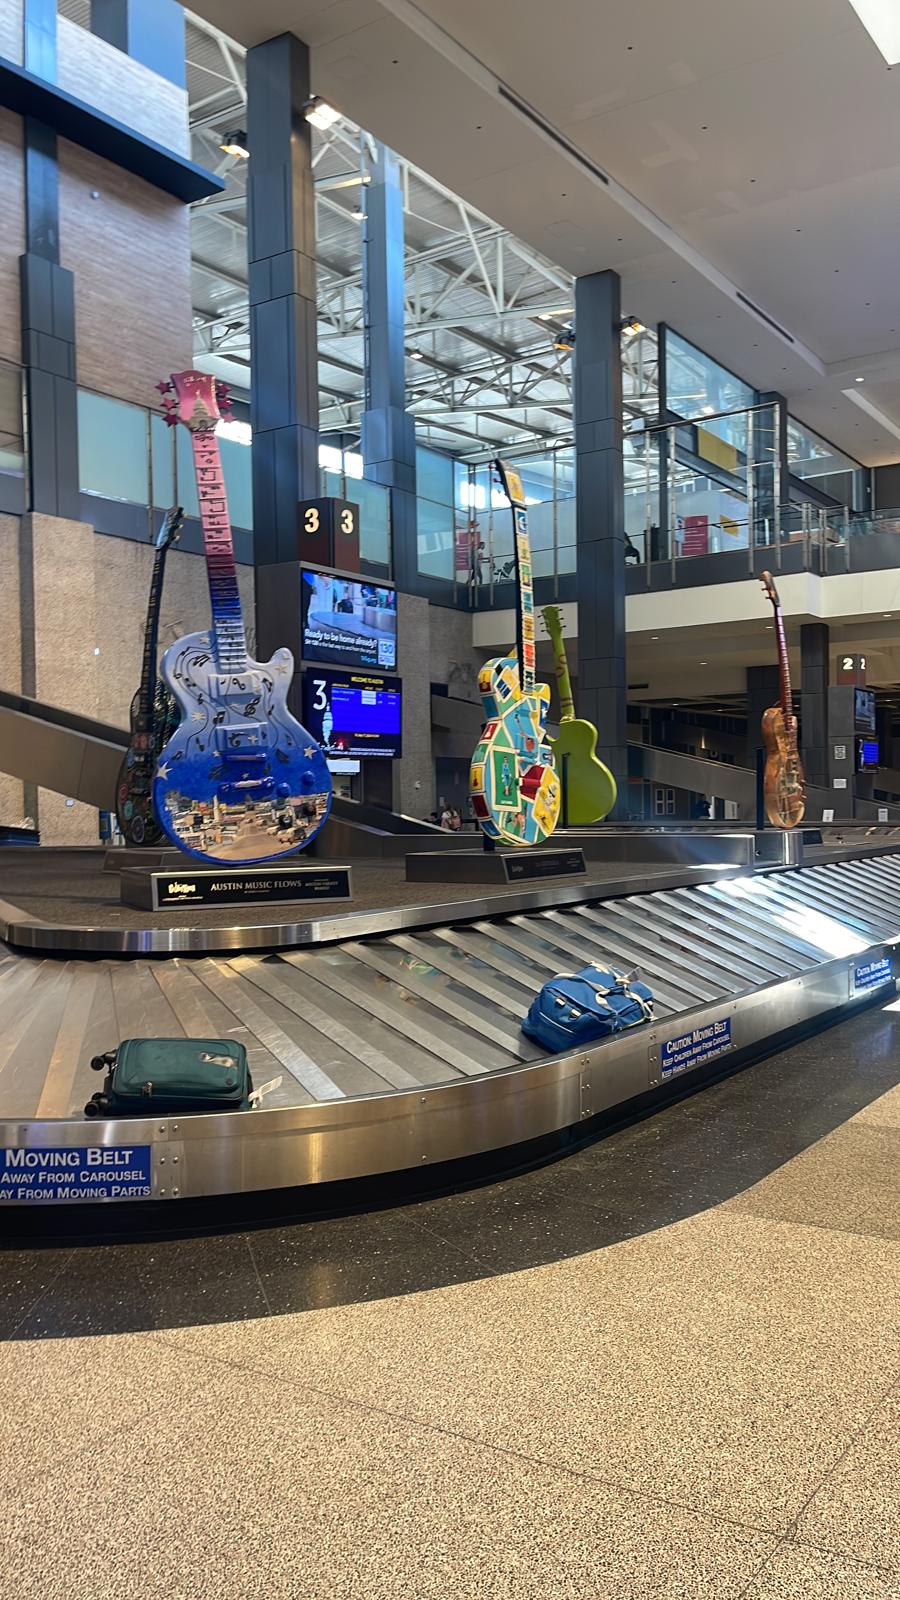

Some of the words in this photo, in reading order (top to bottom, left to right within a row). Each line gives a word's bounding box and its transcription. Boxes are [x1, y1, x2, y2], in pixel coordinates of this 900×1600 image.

[304, 508, 320, 533] 3
[341, 509, 354, 534] 3
[304, 629, 323, 640] Ready
[331, 633, 338, 641] be
[339, 634, 355, 643] home
[356, 637, 377, 648] already?
[843, 658, 853, 670] 2
[860, 658, 866, 670] 2
[313, 680, 327, 710] 3
[210, 882, 243, 891] AUSTIN
[244, 880, 273, 890] MUSIC
[274, 880, 302, 888] FLOWS
[693, 1028, 713, 1043] MOVING
[714, 1022, 727, 1034] BELT
[662, 1070, 672, 1079] KEEP
[697, 1055, 707, 1063] FROM
[663, 1058, 673, 1067] KEEP
[5, 1148, 80, 1168] MOVING
[87, 1148, 133, 1166] BELT
[1, 1172, 35, 1184] AWAY
[38, 1172, 75, 1183] FROM
[80, 1170, 146, 1182] CAROUSEL
[0, 1188, 14, 1199] AY
[18, 1187, 53, 1199] FROM
[57, 1187, 107, 1198] MOVING
[111, 1185, 151, 1197] PARTS
